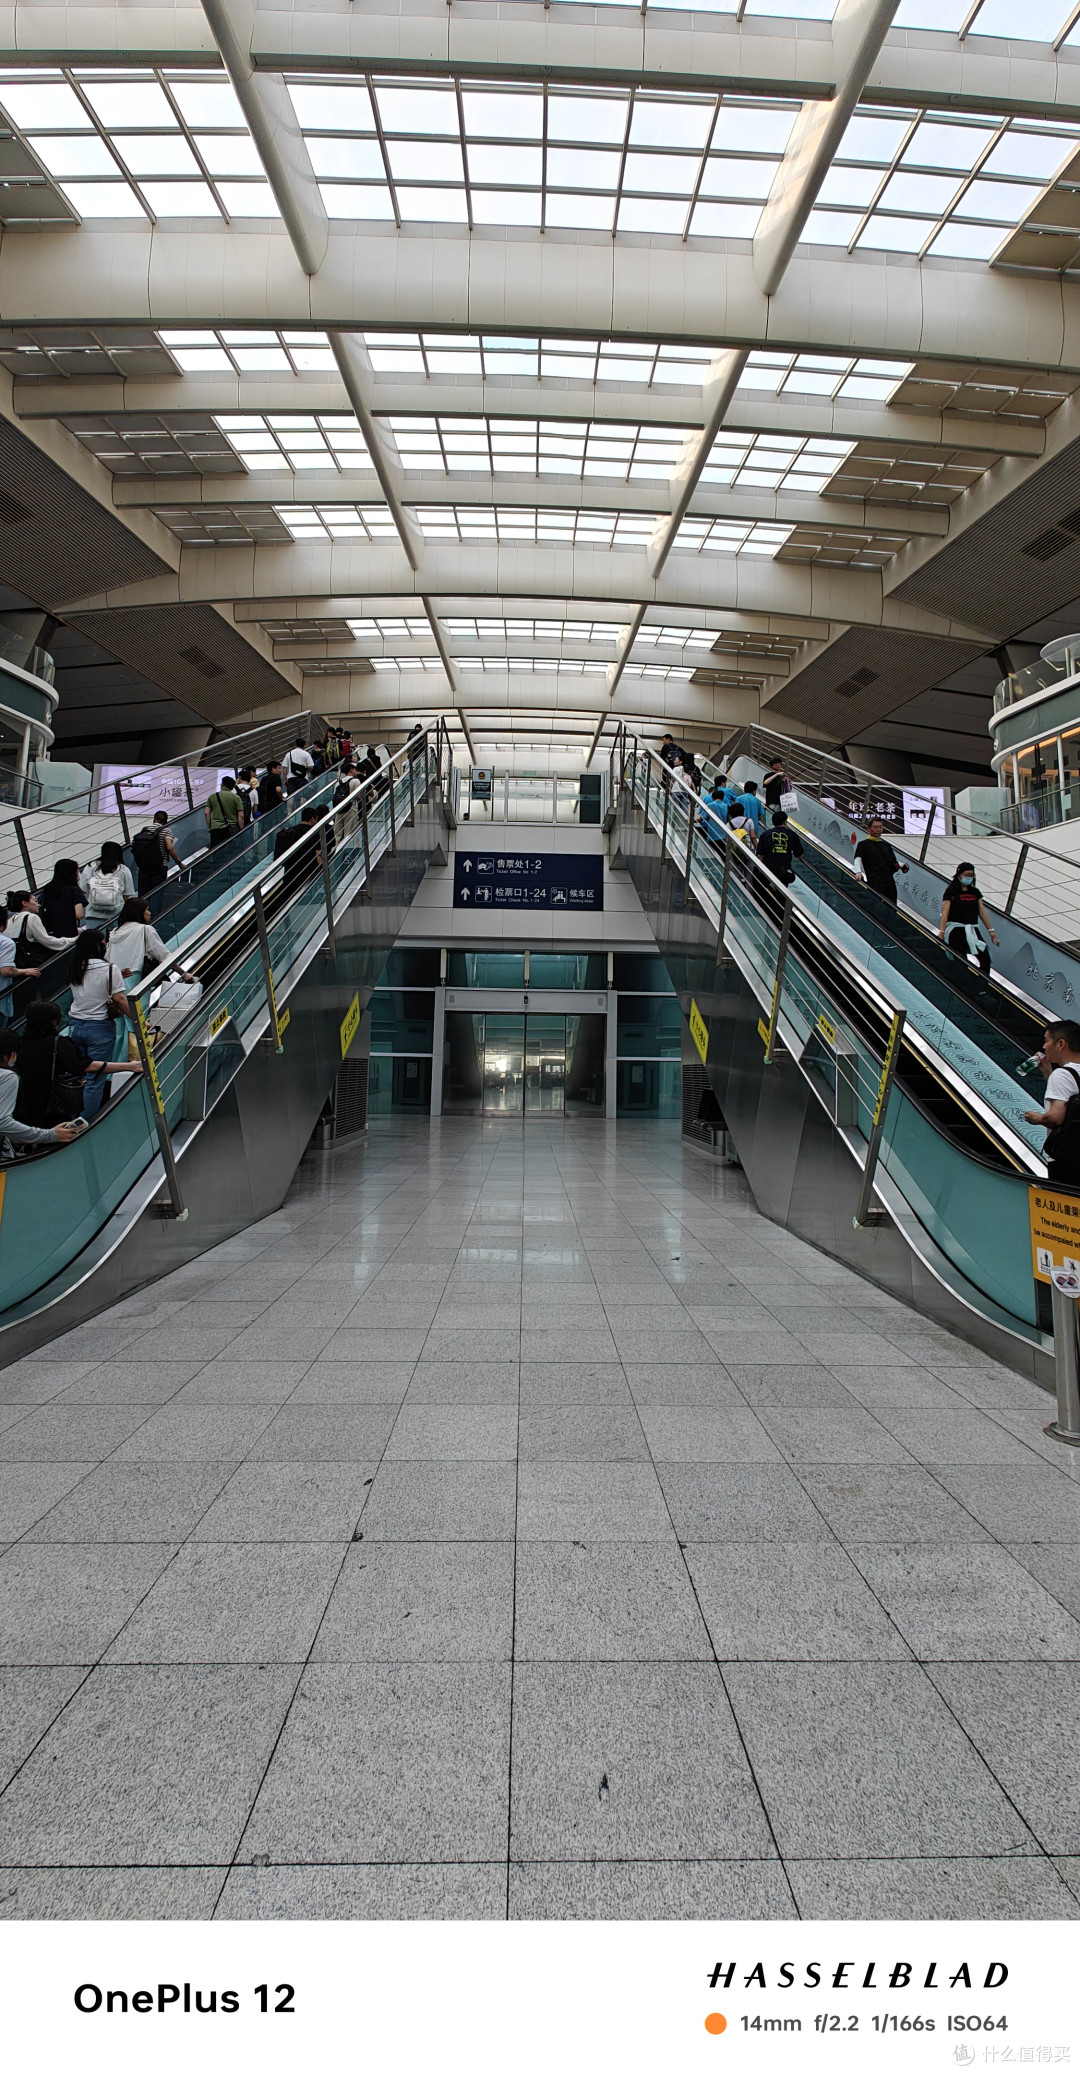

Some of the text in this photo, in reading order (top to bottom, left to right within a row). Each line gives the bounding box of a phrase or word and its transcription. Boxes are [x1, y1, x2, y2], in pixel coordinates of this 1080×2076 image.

[494, 887, 547, 898] 检票口1-24
[569, 889, 595, 899] 候车区
[1040, 1216, 1051, 1226] The
[1051, 1220, 1070, 1233] elderly
[1033, 1227, 1041, 1236] be
